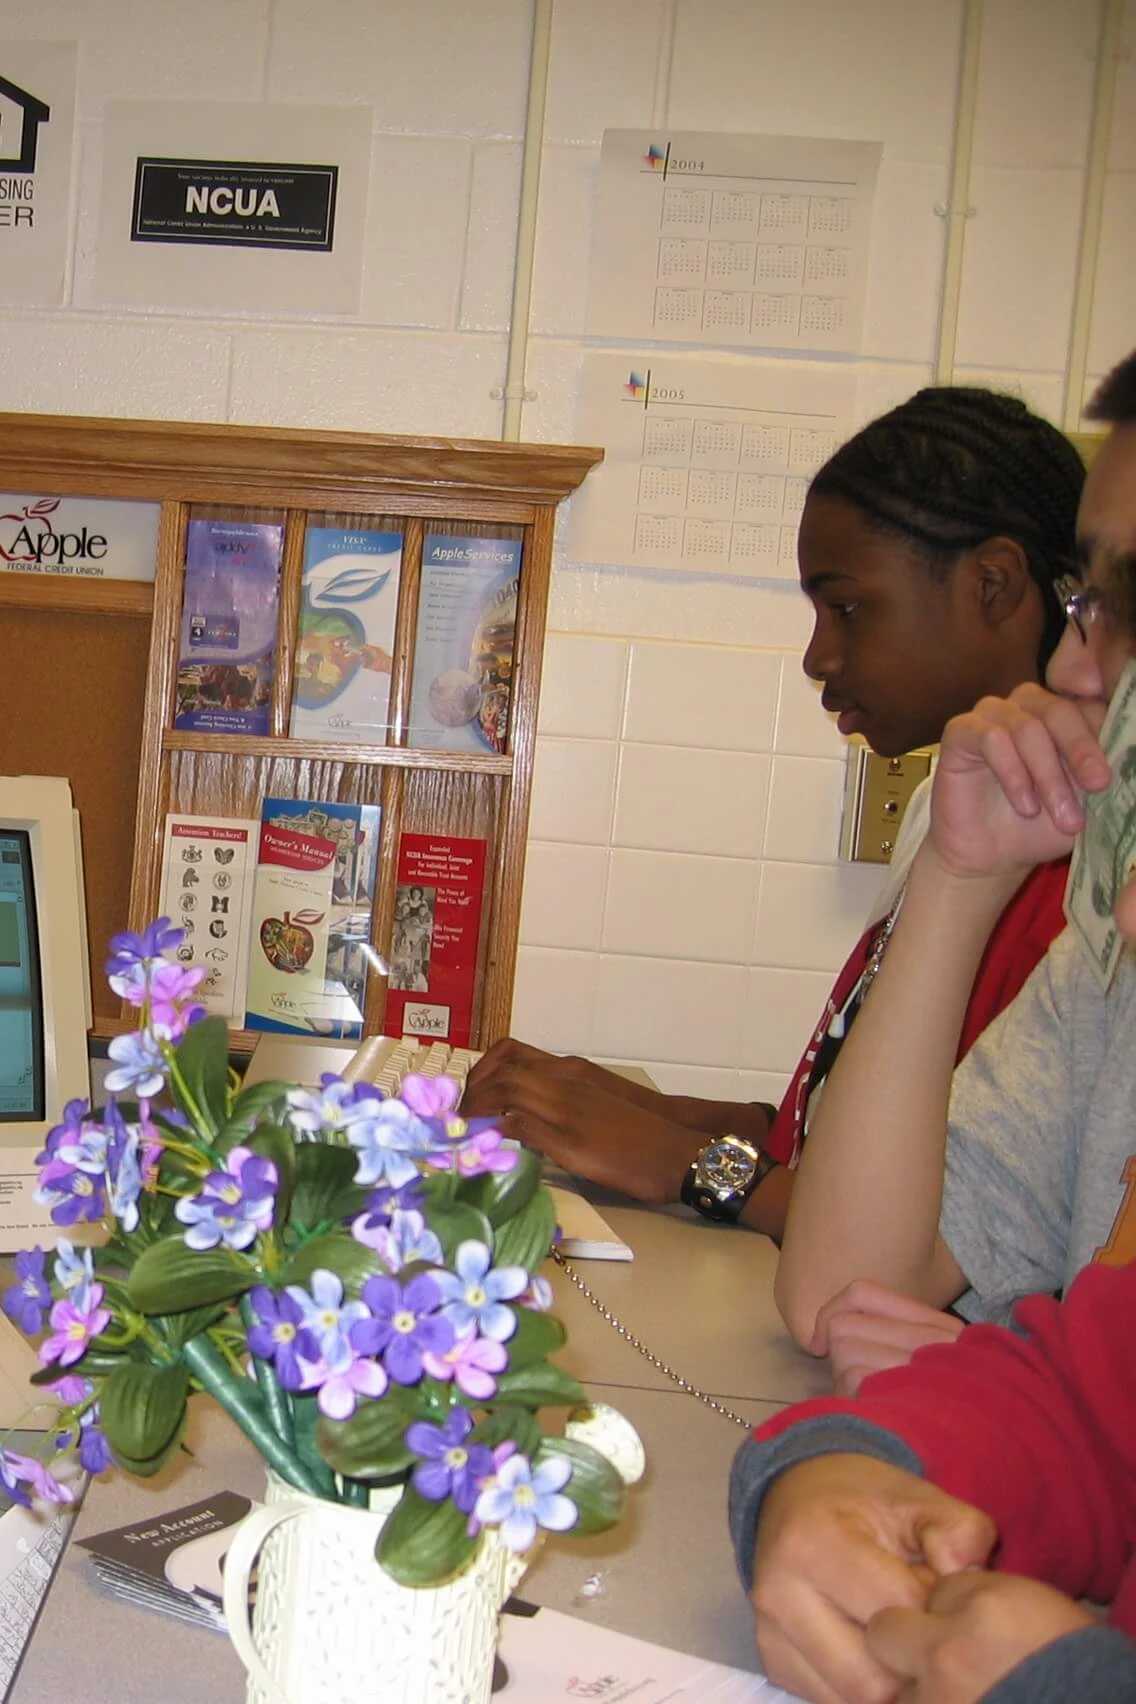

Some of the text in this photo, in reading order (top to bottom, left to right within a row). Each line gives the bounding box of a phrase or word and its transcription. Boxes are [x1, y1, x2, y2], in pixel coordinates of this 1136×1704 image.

[670, 158, 705, 171] 2004
[185, 186, 281, 218] NCUA
[143, 218, 166, 226] National
[185, 220, 202, 228] Union
[265, 225, 300, 234] Government
[301, 227, 322, 236] Agency
[652, 387, 685, 400] 2005
[7, 525, 108, 564] Apple
[7, 563, 104, 576] FEDERAL CREDIT UNION
[264, 834, 333, 860] Owner's Manual
[123, 1508, 217, 1545] New Account
